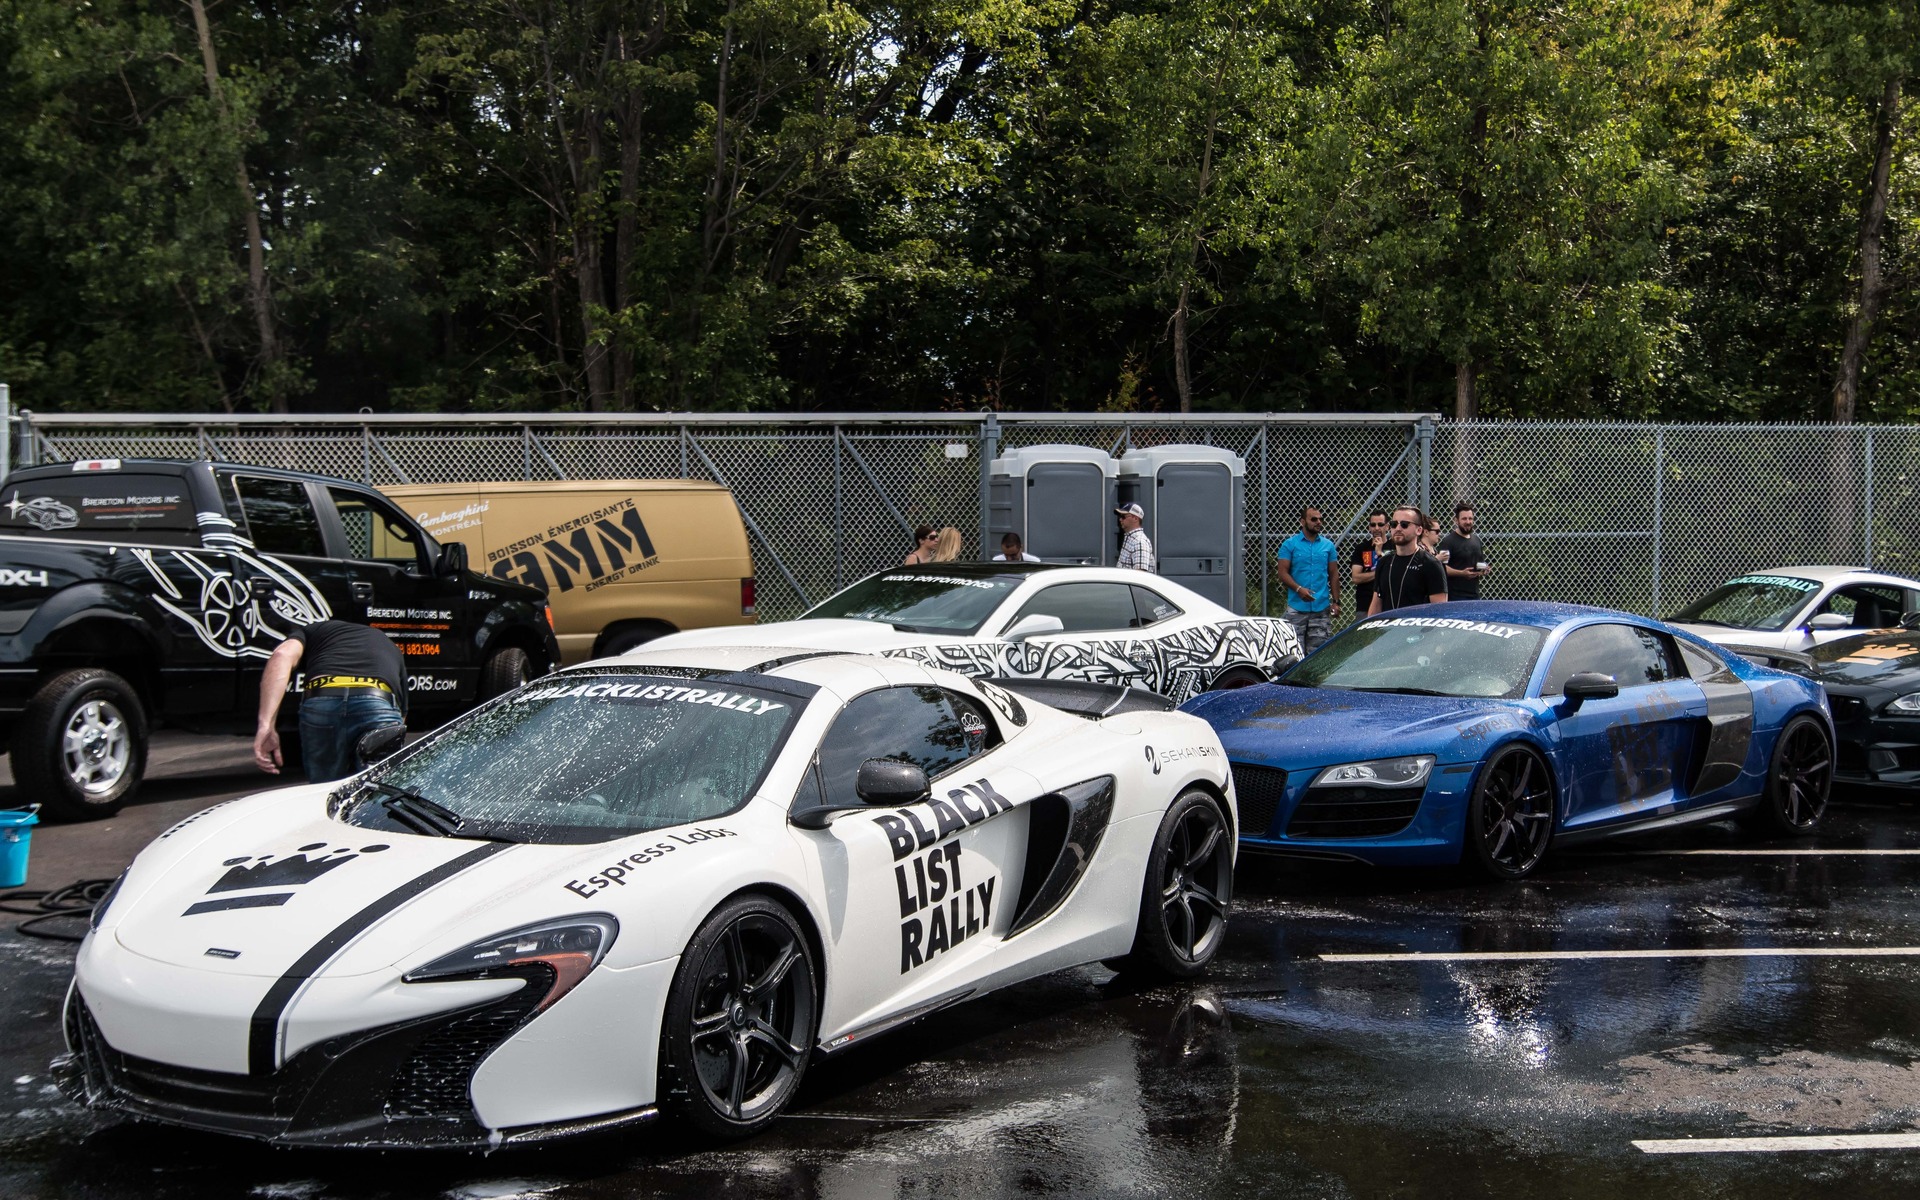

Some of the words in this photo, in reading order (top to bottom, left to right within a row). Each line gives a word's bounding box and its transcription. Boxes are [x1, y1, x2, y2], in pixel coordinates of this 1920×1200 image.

[126, 496, 163, 505] MOTORS
[416, 500, 489, 528] Lamborghini
[487, 533, 544, 562] BOISSON
[547, 498, 635, 538] ÉNERGISANTE
[585, 570, 625, 592] ENERGY
[628, 556, 660, 574] DRINK
[366, 606, 406, 618] BRERETON
[407, 608, 438, 620] MOTORS
[439, 611, 453, 620] INC.
[1357, 617, 1522, 639] #BLACKLISTRALLY
[516, 683, 785, 716] #BLACKLISTRALLY
[871, 778, 1015, 862] BLACK
[563, 842, 676, 900] Espress
[667, 828, 738, 845] Labs
[894, 839, 962, 919] LIST
[901, 875, 996, 975] RALLY
